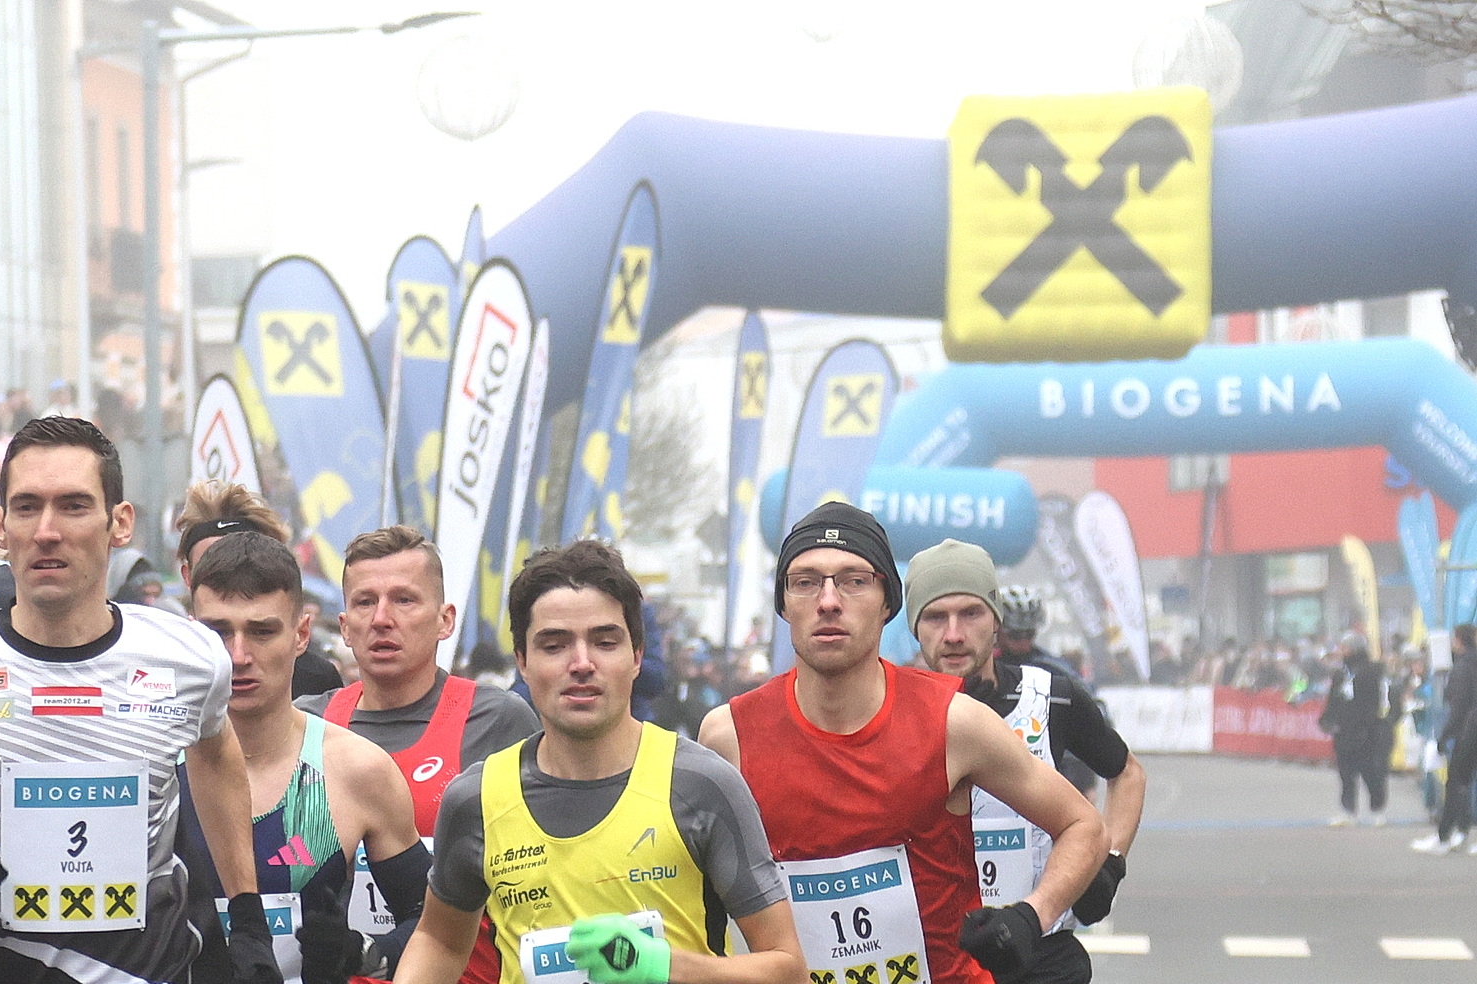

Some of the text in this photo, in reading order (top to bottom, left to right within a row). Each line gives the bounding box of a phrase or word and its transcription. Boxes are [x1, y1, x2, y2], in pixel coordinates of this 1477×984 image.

[1040, 372, 1342, 418] BIOGENA
[450, 342, 509, 518] josko
[861, 489, 1006, 530] FINISH
[142, 682, 173, 691] WEMOVE
[132, 703, 188, 718] FITMACHER
[22, 785, 132, 801] BIOGENA
[67, 820, 88, 858] 3
[60, 861, 94, 873] VOJTA
[629, 865, 678, 883] EnBW
[982, 860, 997, 886] 9
[797, 868, 894, 895] BIOGENA
[498, 886, 550, 908] infinex
[533, 902, 553, 911] Group
[830, 906, 873, 944] 16
[831, 940, 882, 958] ZEMANIK
